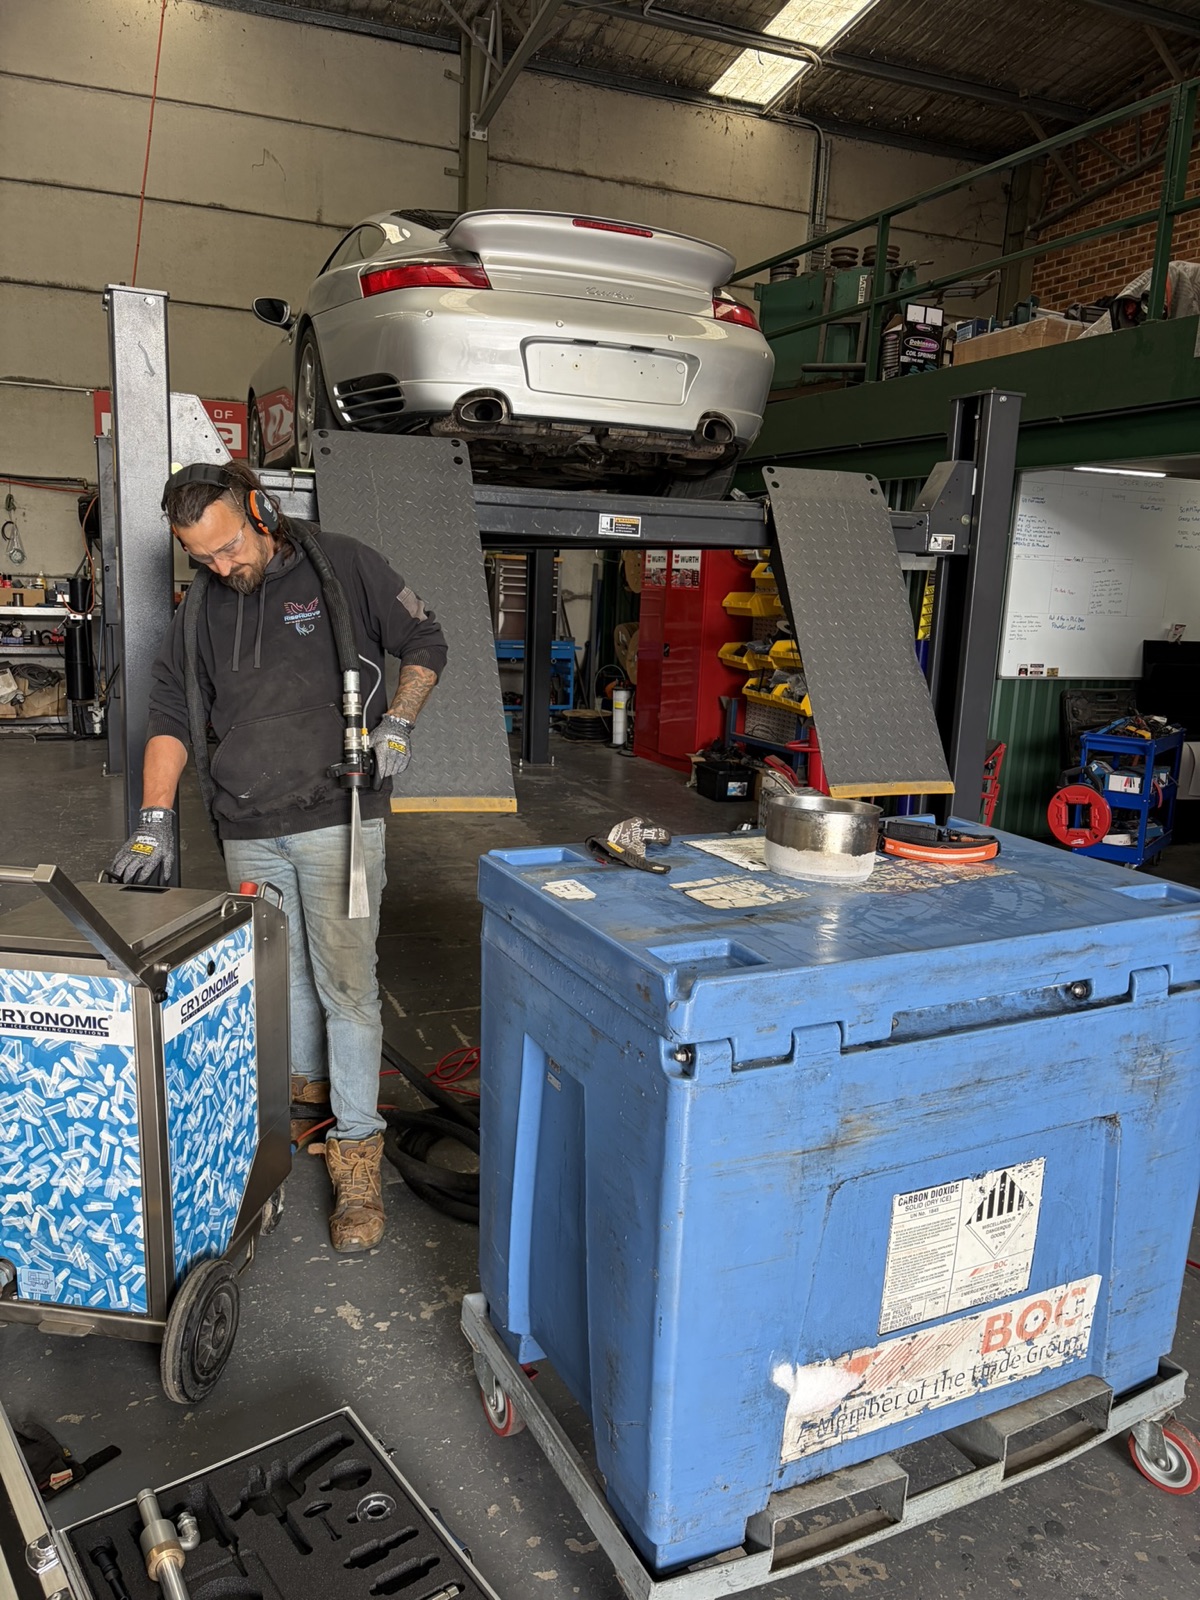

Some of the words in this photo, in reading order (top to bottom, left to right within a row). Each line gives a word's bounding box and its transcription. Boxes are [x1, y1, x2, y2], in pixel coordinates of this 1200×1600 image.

[917, 351, 937, 360] SPRINGS
[214, 409, 233, 419] OF
[181, 967, 239, 1017] CRYONOMIC
[0, 1008, 109, 1030] RYONOMIC
[25, 1025, 62, 1033] CLEANING
[65, 1028, 106, 1037] SOLUTIONS
[898, 1191, 929, 1207] CARBON
[930, 1183, 960, 1199] DIOXIDE
[905, 1202, 923, 1212] SOLID
[924, 1198, 939, 1208] (DRY
[940, 1195, 952, 1203] ICE)
[993, 1259, 1009, 1270] BOC
[981, 1286, 1087, 1355] BOC
[907, 1379, 930, 1405] of
[933, 1369, 966, 1396] the
